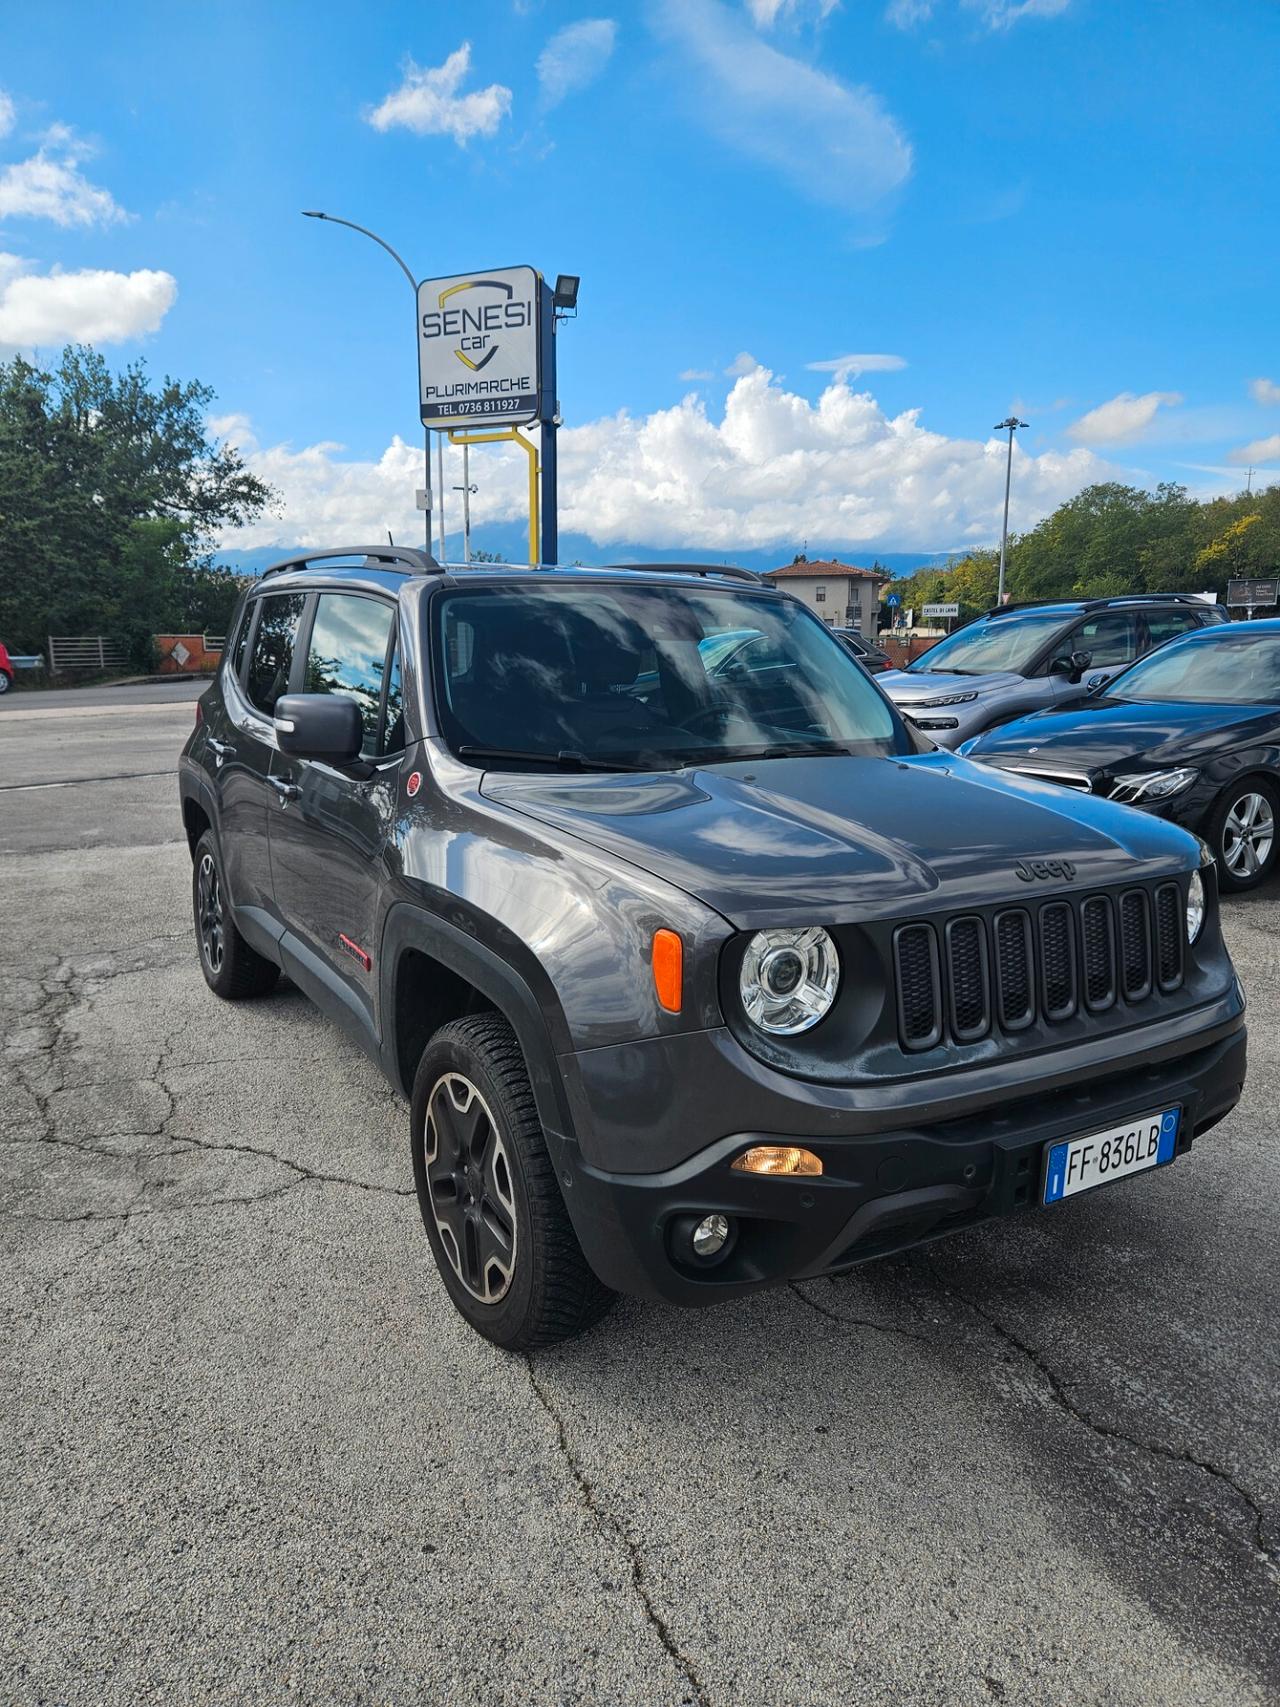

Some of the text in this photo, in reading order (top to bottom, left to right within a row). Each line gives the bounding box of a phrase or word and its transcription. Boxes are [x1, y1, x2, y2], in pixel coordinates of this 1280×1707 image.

[423, 301, 531, 338] SENESI
[461, 335, 490, 351] car
[426, 377, 530, 399] PLURIMARCHE
[437, 399, 520, 415] TEL. 0736 811927
[1015, 859, 1077, 882] Jeep
